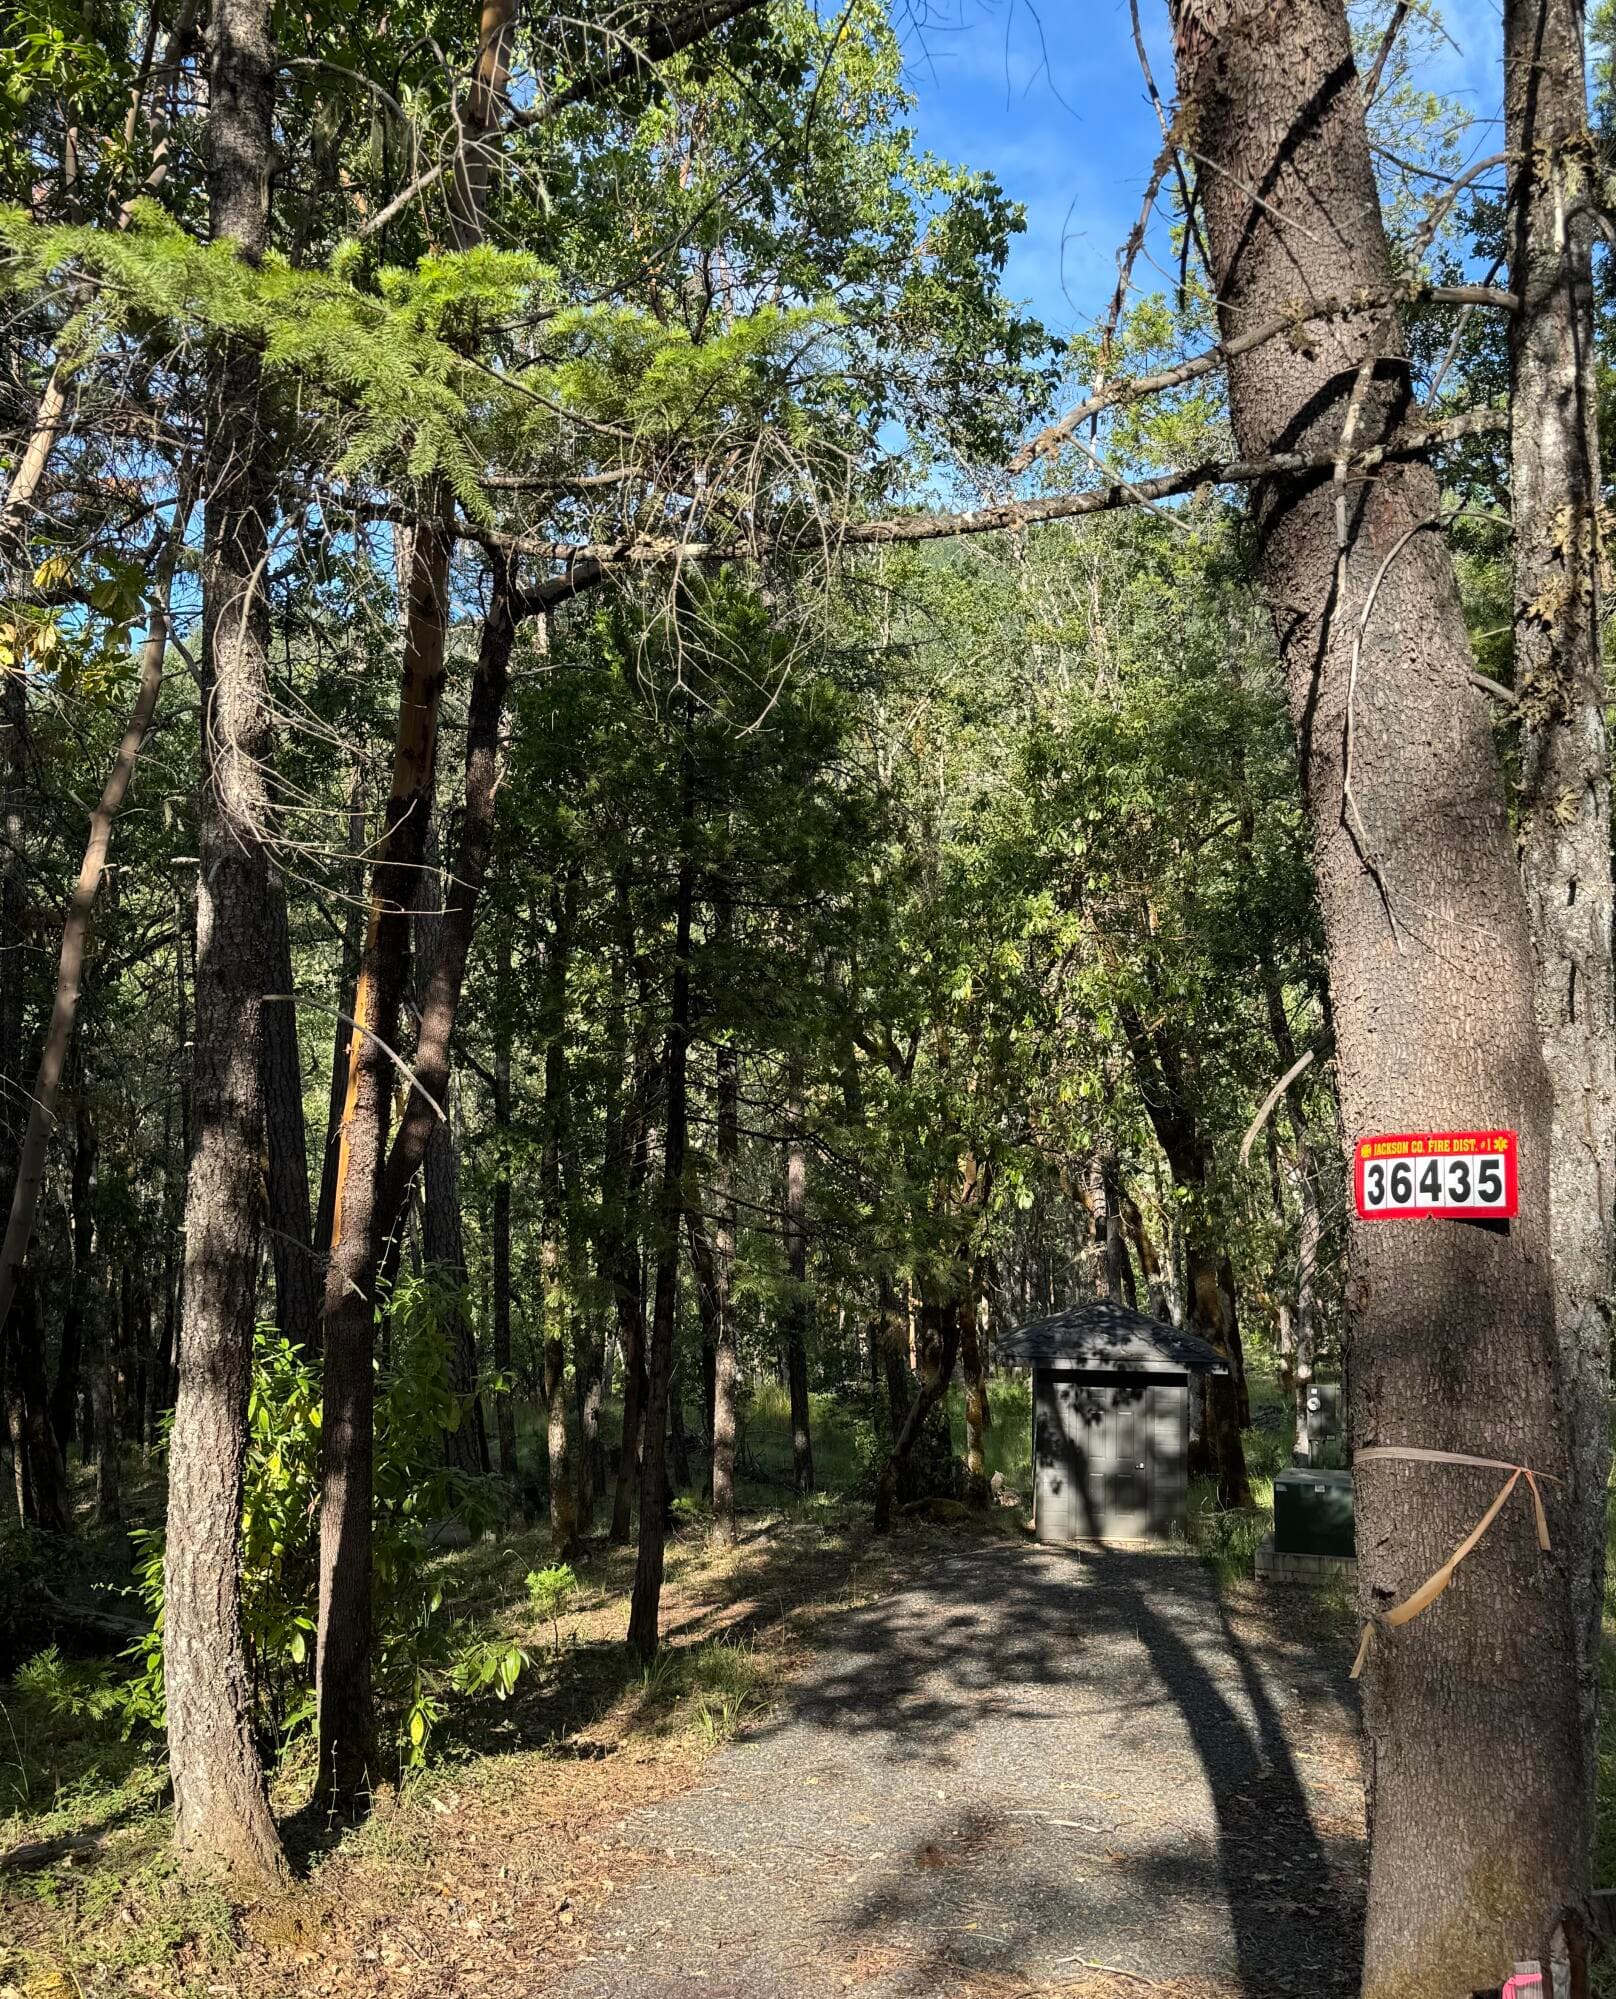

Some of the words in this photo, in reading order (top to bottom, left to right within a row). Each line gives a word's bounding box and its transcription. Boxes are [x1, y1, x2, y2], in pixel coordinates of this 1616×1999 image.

[1374, 1141, 1409, 1156] JACKSON
[1411, 1140, 1425, 1153] CO.
[1428, 1139, 1451, 1153] FIRE
[1453, 1138, 1478, 1152] DIST.
[1367, 1159, 1502, 1205] 36435
